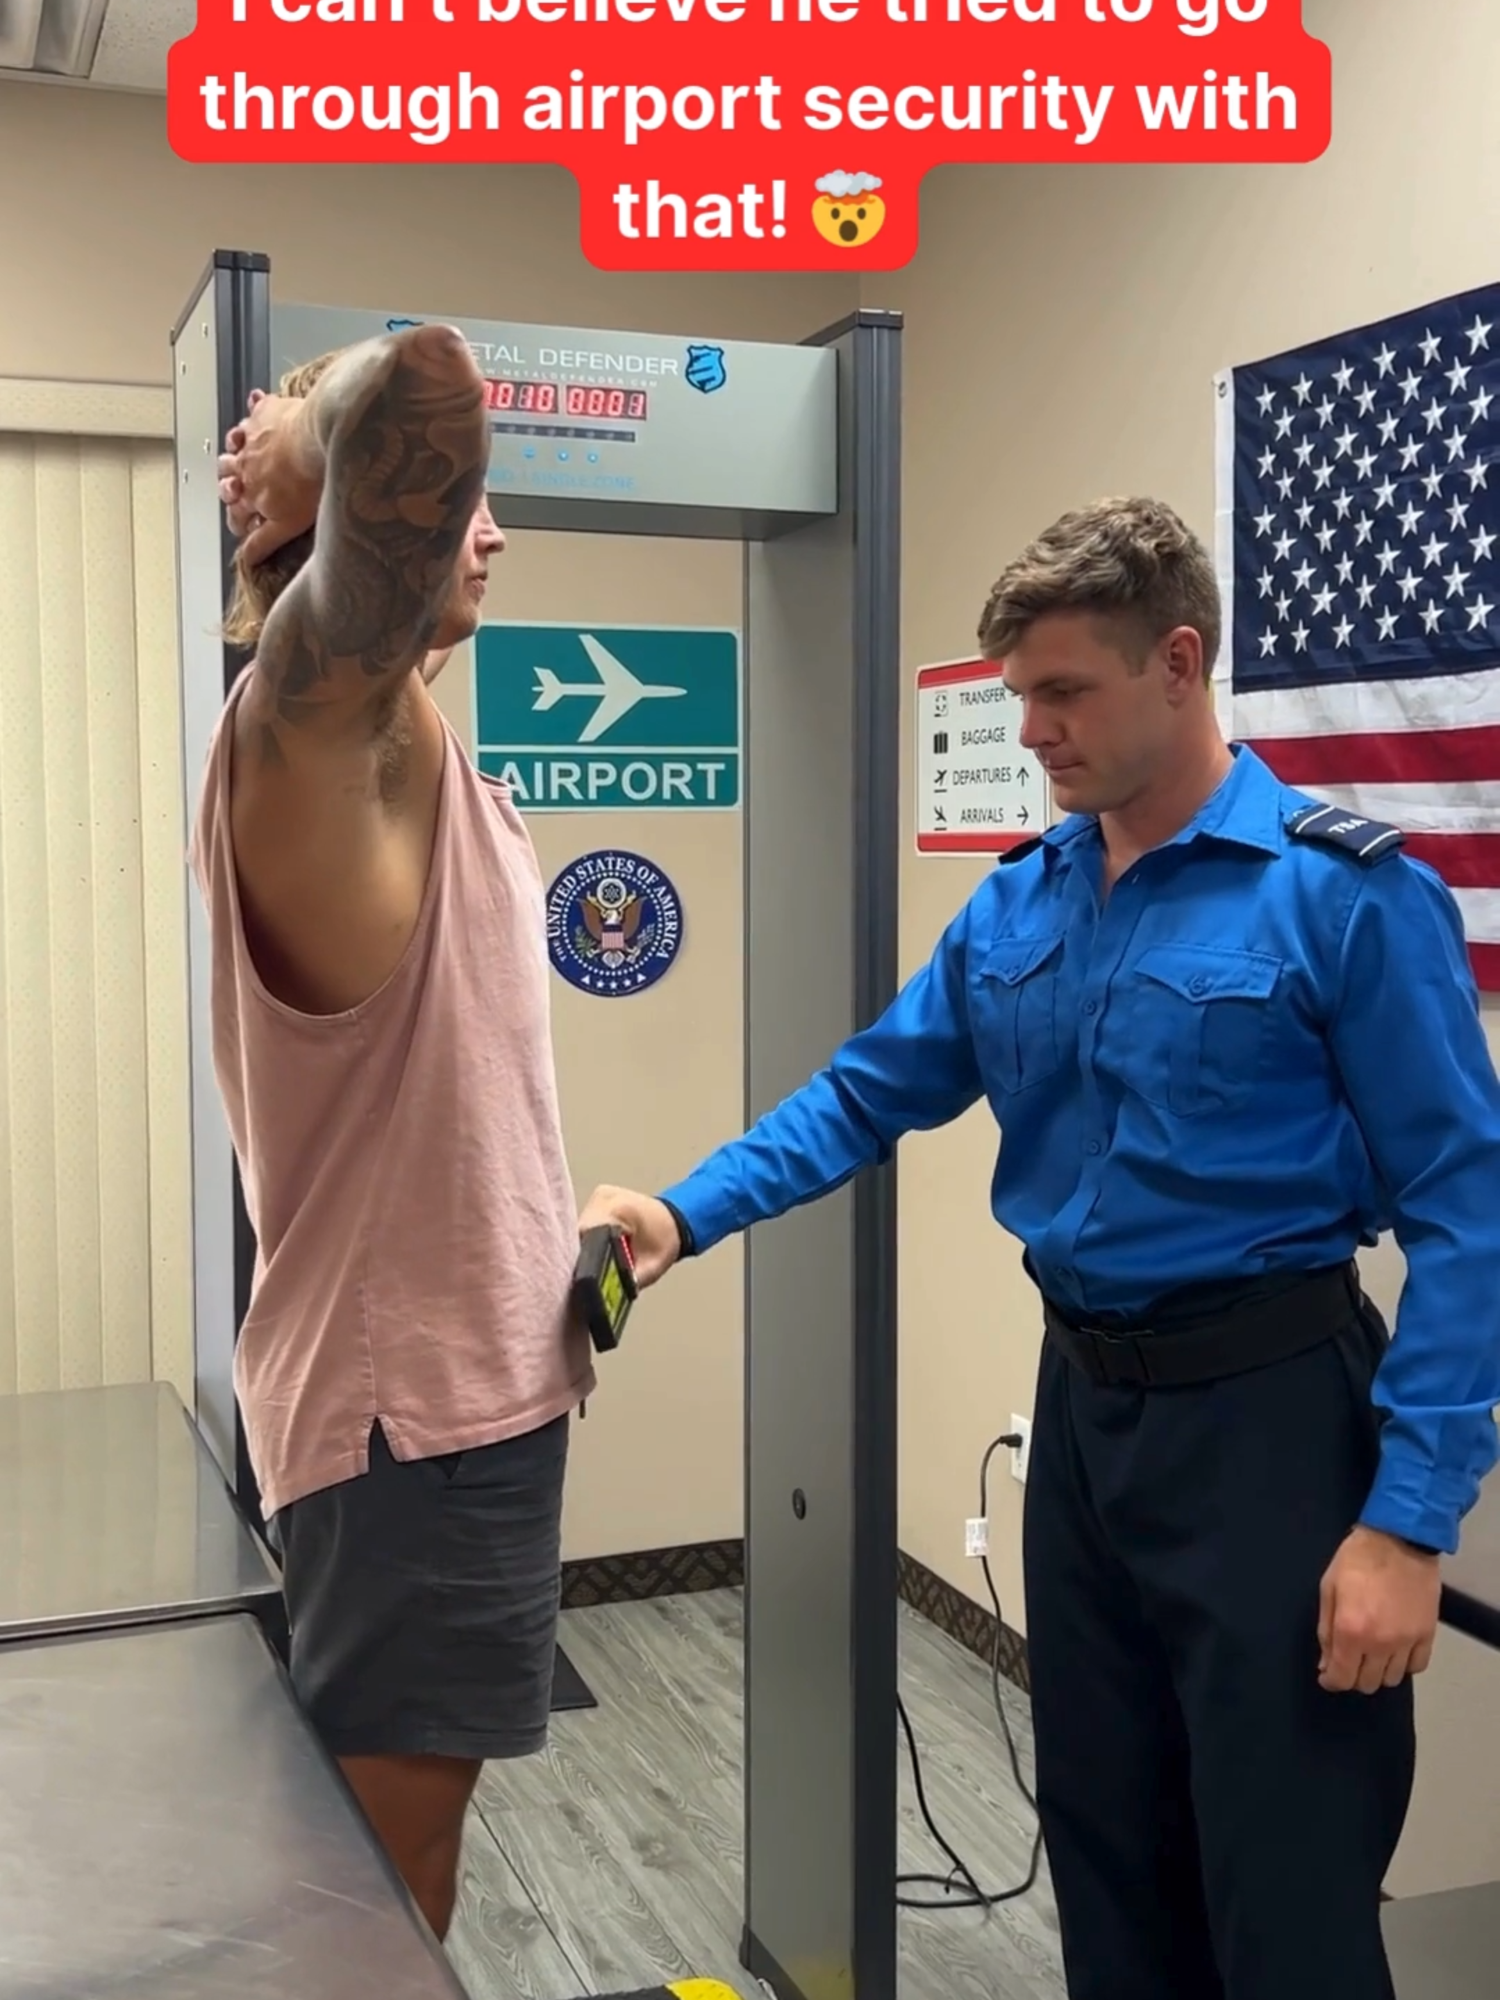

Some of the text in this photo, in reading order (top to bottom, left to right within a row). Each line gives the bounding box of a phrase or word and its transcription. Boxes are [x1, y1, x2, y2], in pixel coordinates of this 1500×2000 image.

[468, 341, 679, 376] ETAL DEFENDER
[567, 386, 645, 417] 0001
[960, 686, 1007, 706] TRANSFER
[961, 726, 1006, 746] BAGGAGE
[500, 761, 726, 800] AIRPORT
[952, 766, 1012, 786] DEPARTURES
[960, 807, 1004, 824] ARRIVALS
[1327, 818, 1369, 834] TSA
[547, 875, 577, 938] UNITED
[575, 857, 636, 880] STATES
[637, 866, 660, 885] OF
[654, 885, 678, 959] AMERICA
